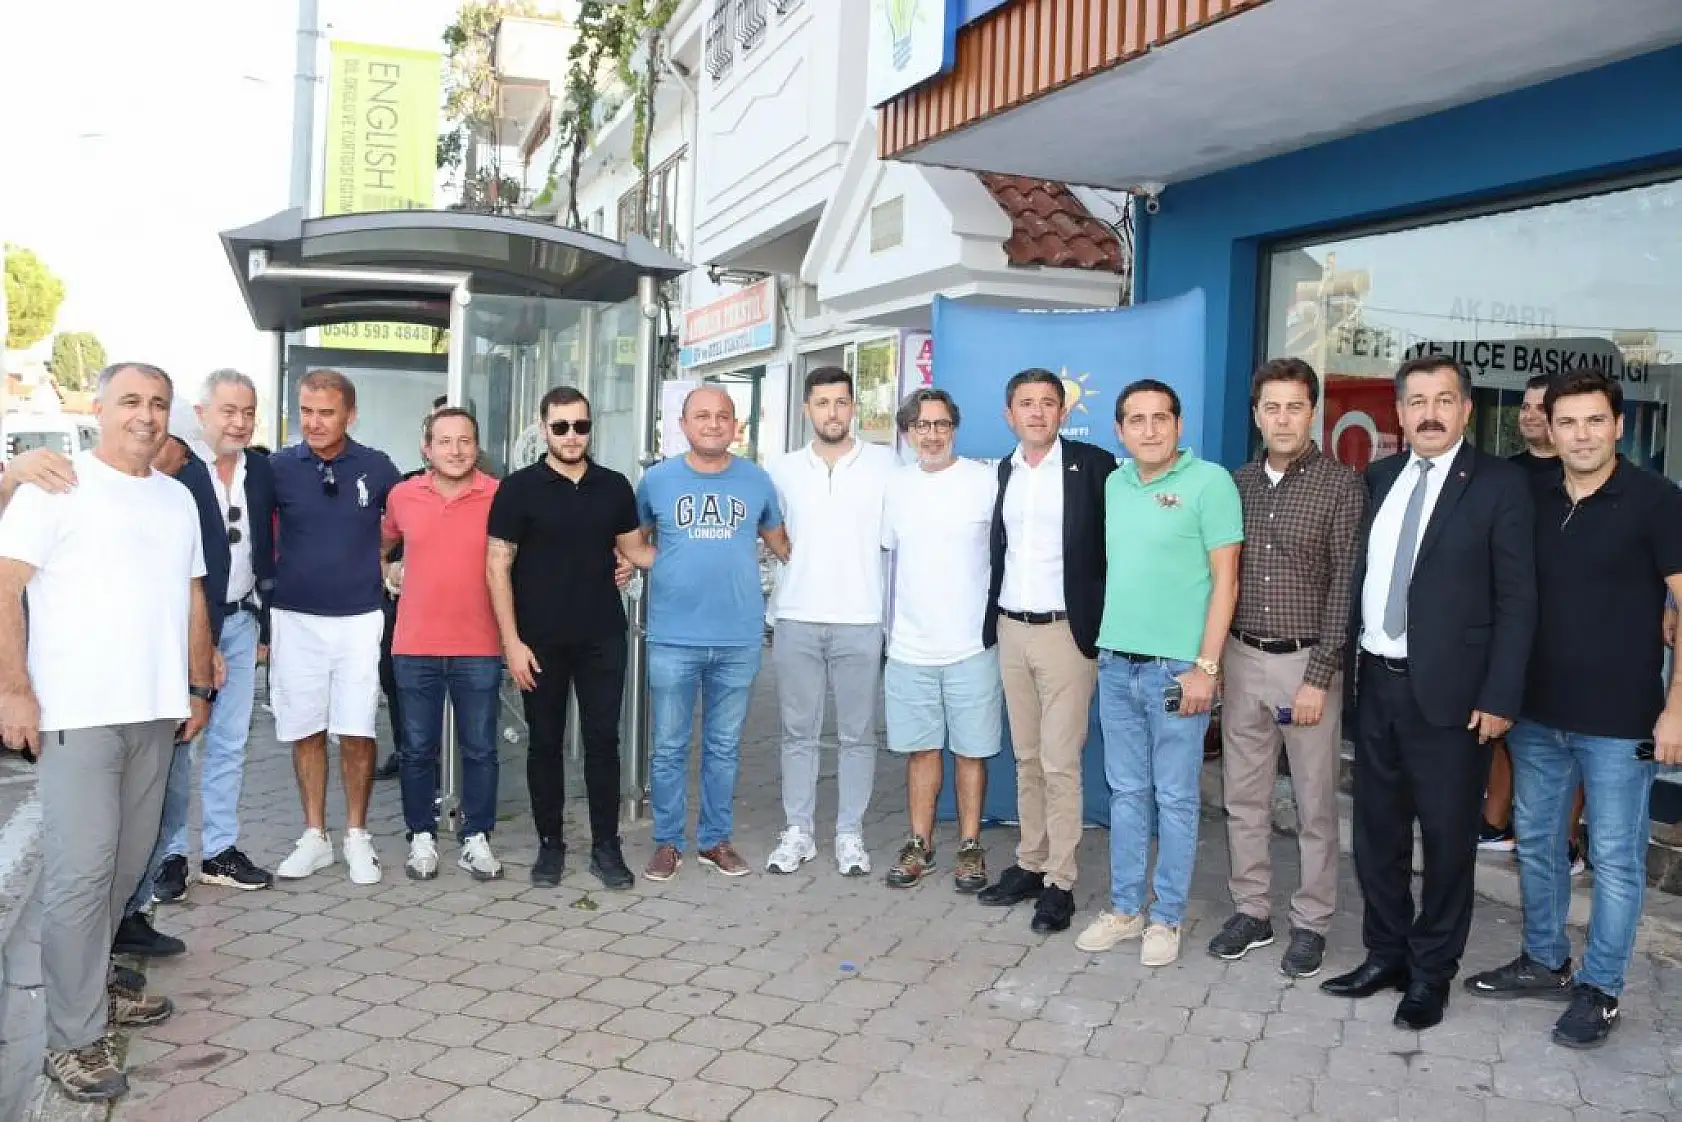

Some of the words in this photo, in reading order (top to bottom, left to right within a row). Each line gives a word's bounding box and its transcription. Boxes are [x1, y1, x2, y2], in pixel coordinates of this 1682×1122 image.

[364, 61, 400, 190] ENGLISH
[364, 324, 390, 339] 593
[675, 493, 747, 529] GAP
[688, 526, 734, 539] LONDON
